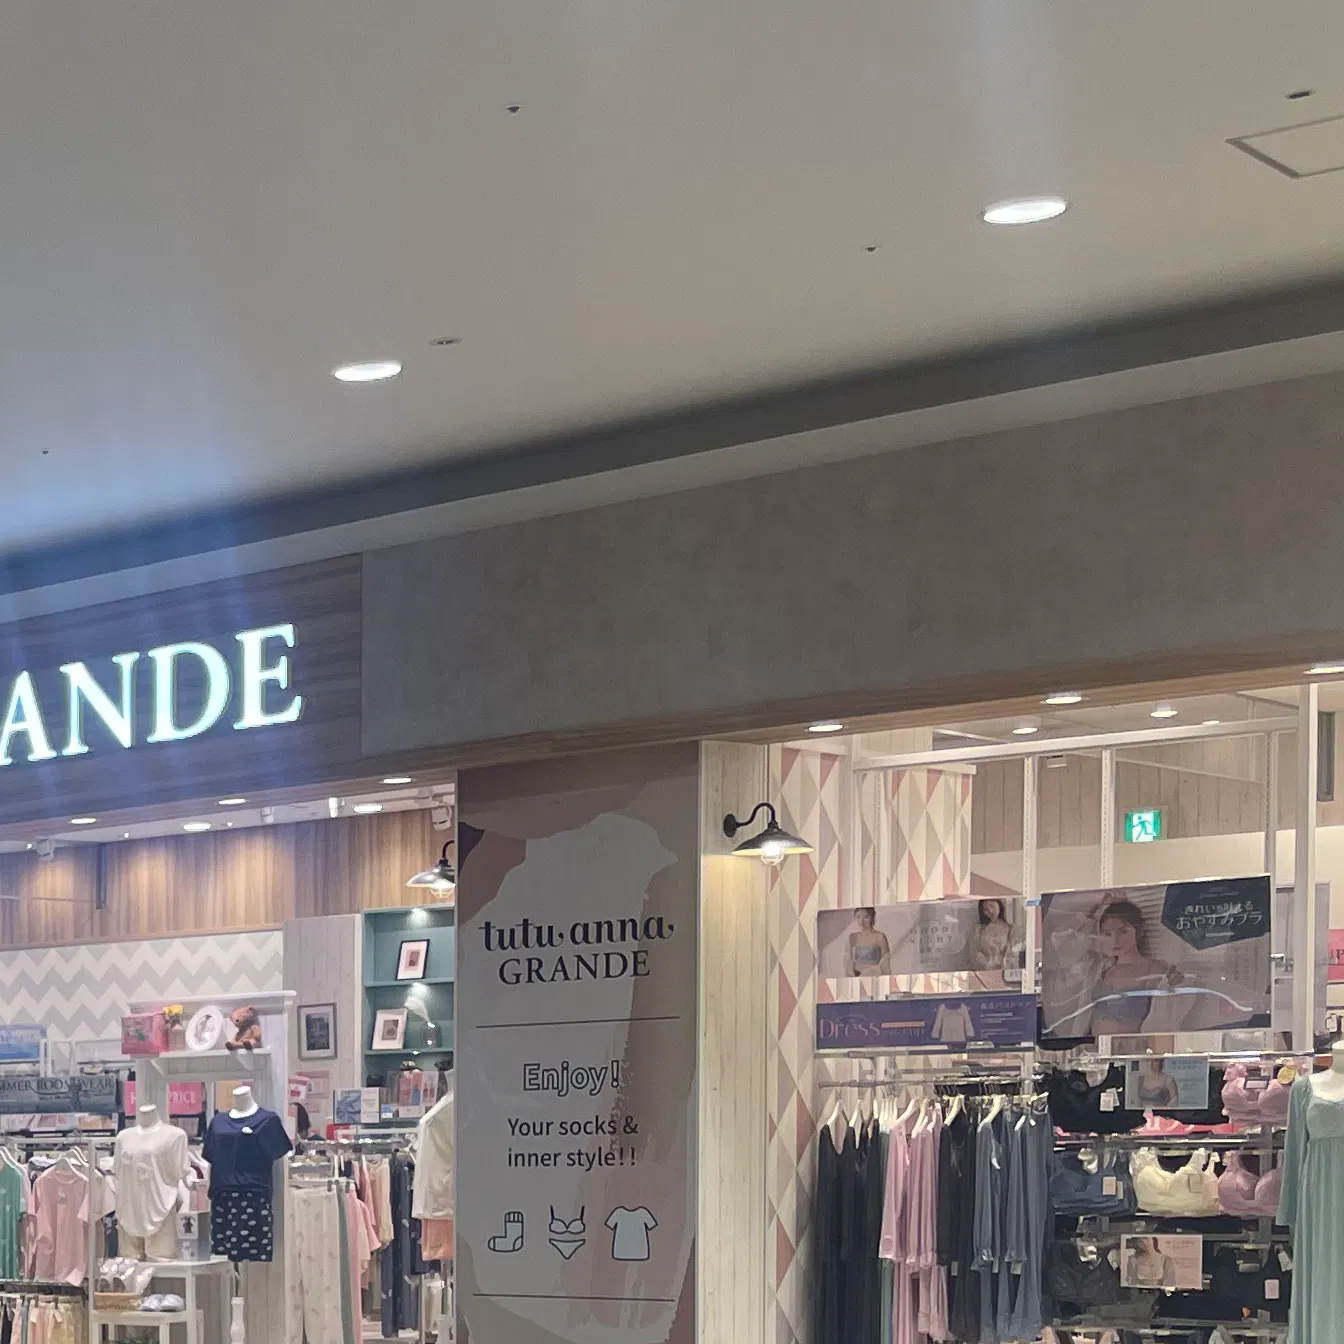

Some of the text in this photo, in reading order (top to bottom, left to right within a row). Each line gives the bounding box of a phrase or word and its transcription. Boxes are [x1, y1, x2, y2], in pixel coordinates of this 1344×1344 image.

[498, 949, 651, 985] GRANDE
[522, 1060, 621, 1097] Enjoy!
[507, 1116, 639, 1136] Your socks &
[508, 1146, 637, 1172] inner style!!
